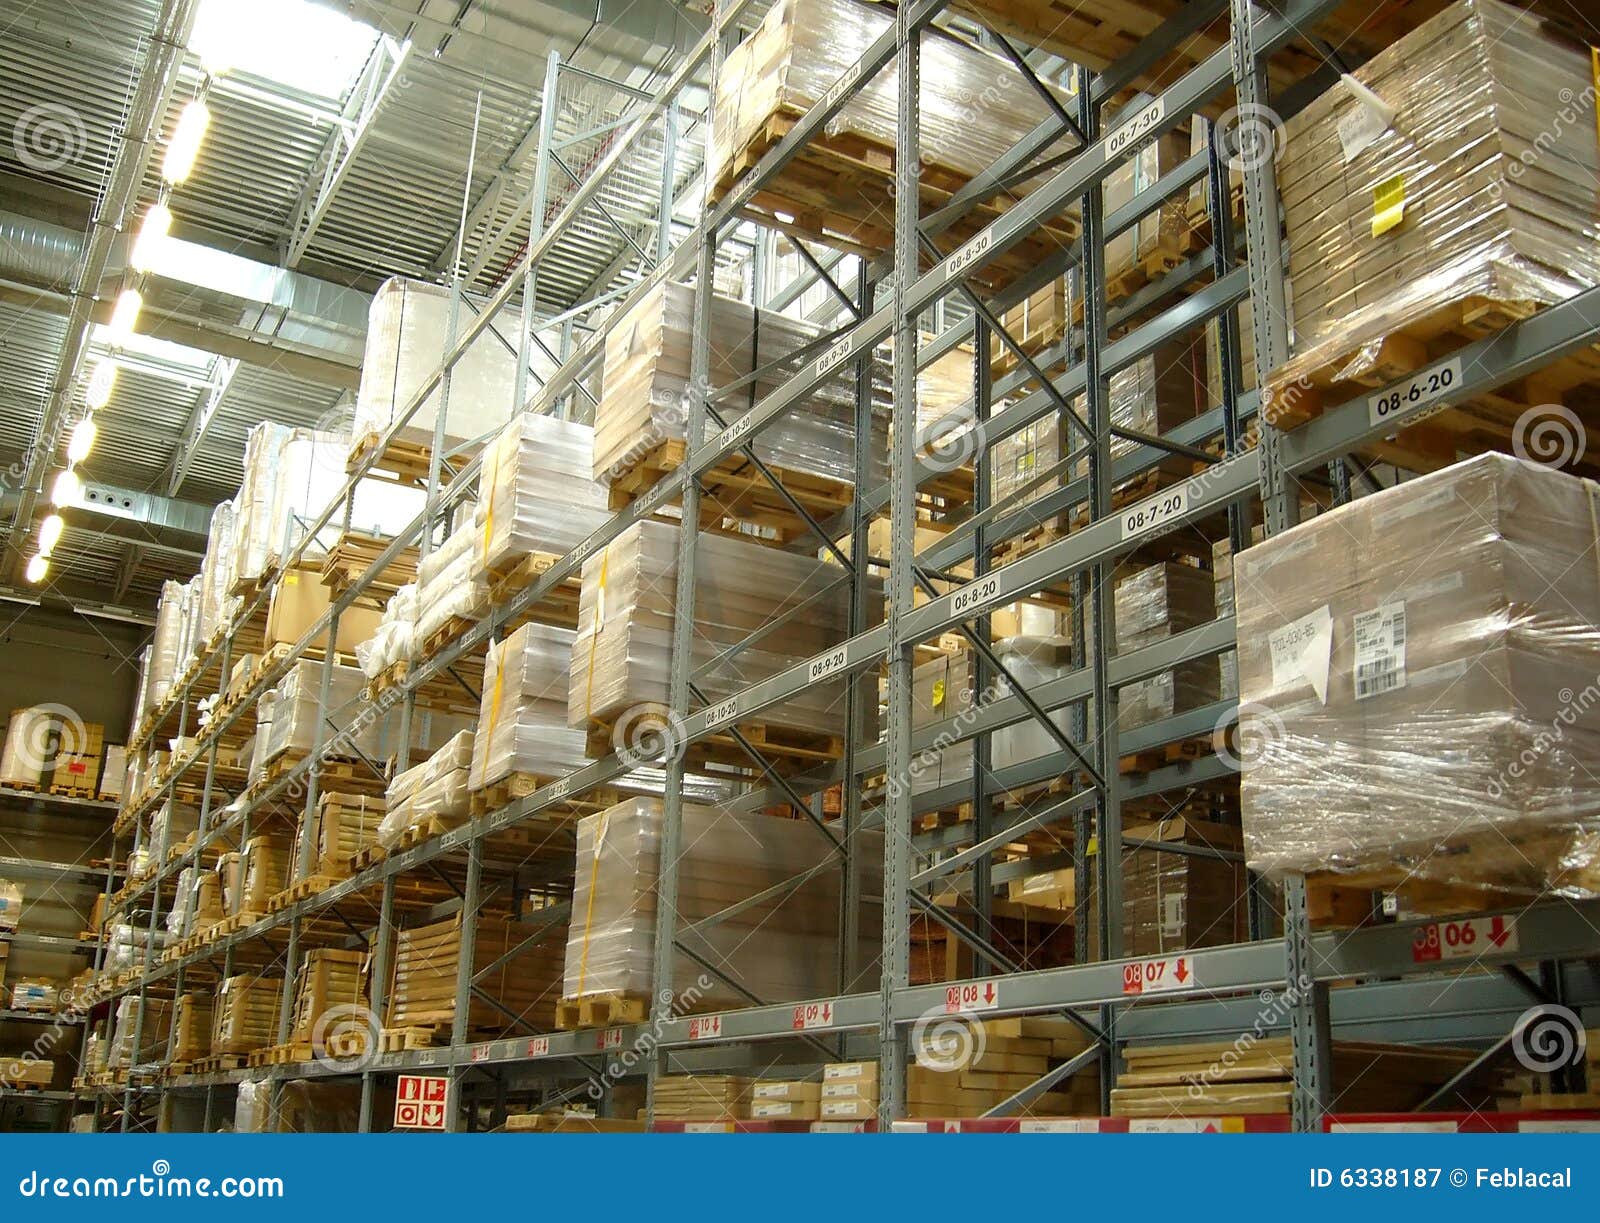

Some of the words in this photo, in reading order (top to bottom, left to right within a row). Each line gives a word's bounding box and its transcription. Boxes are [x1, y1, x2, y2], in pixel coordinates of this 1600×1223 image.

[1110, 107, 1159, 151] 08-7-30
[950, 236, 988, 272] 08-8-30
[819, 341, 850, 371] 08-9-30
[1377, 368, 1453, 416] 08-6-20
[721, 416, 750, 446] 08-10-30
[1127, 494, 1182, 531] 08-7-20
[954, 580, 997, 610] 08-8-20
[811, 652, 845, 677] 08-9-20
[706, 701, 737, 725] 08-10-20
[1444, 921, 1477, 947] 06
[1123, 964, 1142, 984] 08
[1145, 960, 1167, 982] 07
[947, 986, 960, 1005] 08
[963, 984, 978, 1003] 08
[701, 1017, 710, 1031] 10
[806, 1005, 818, 1020] 09
